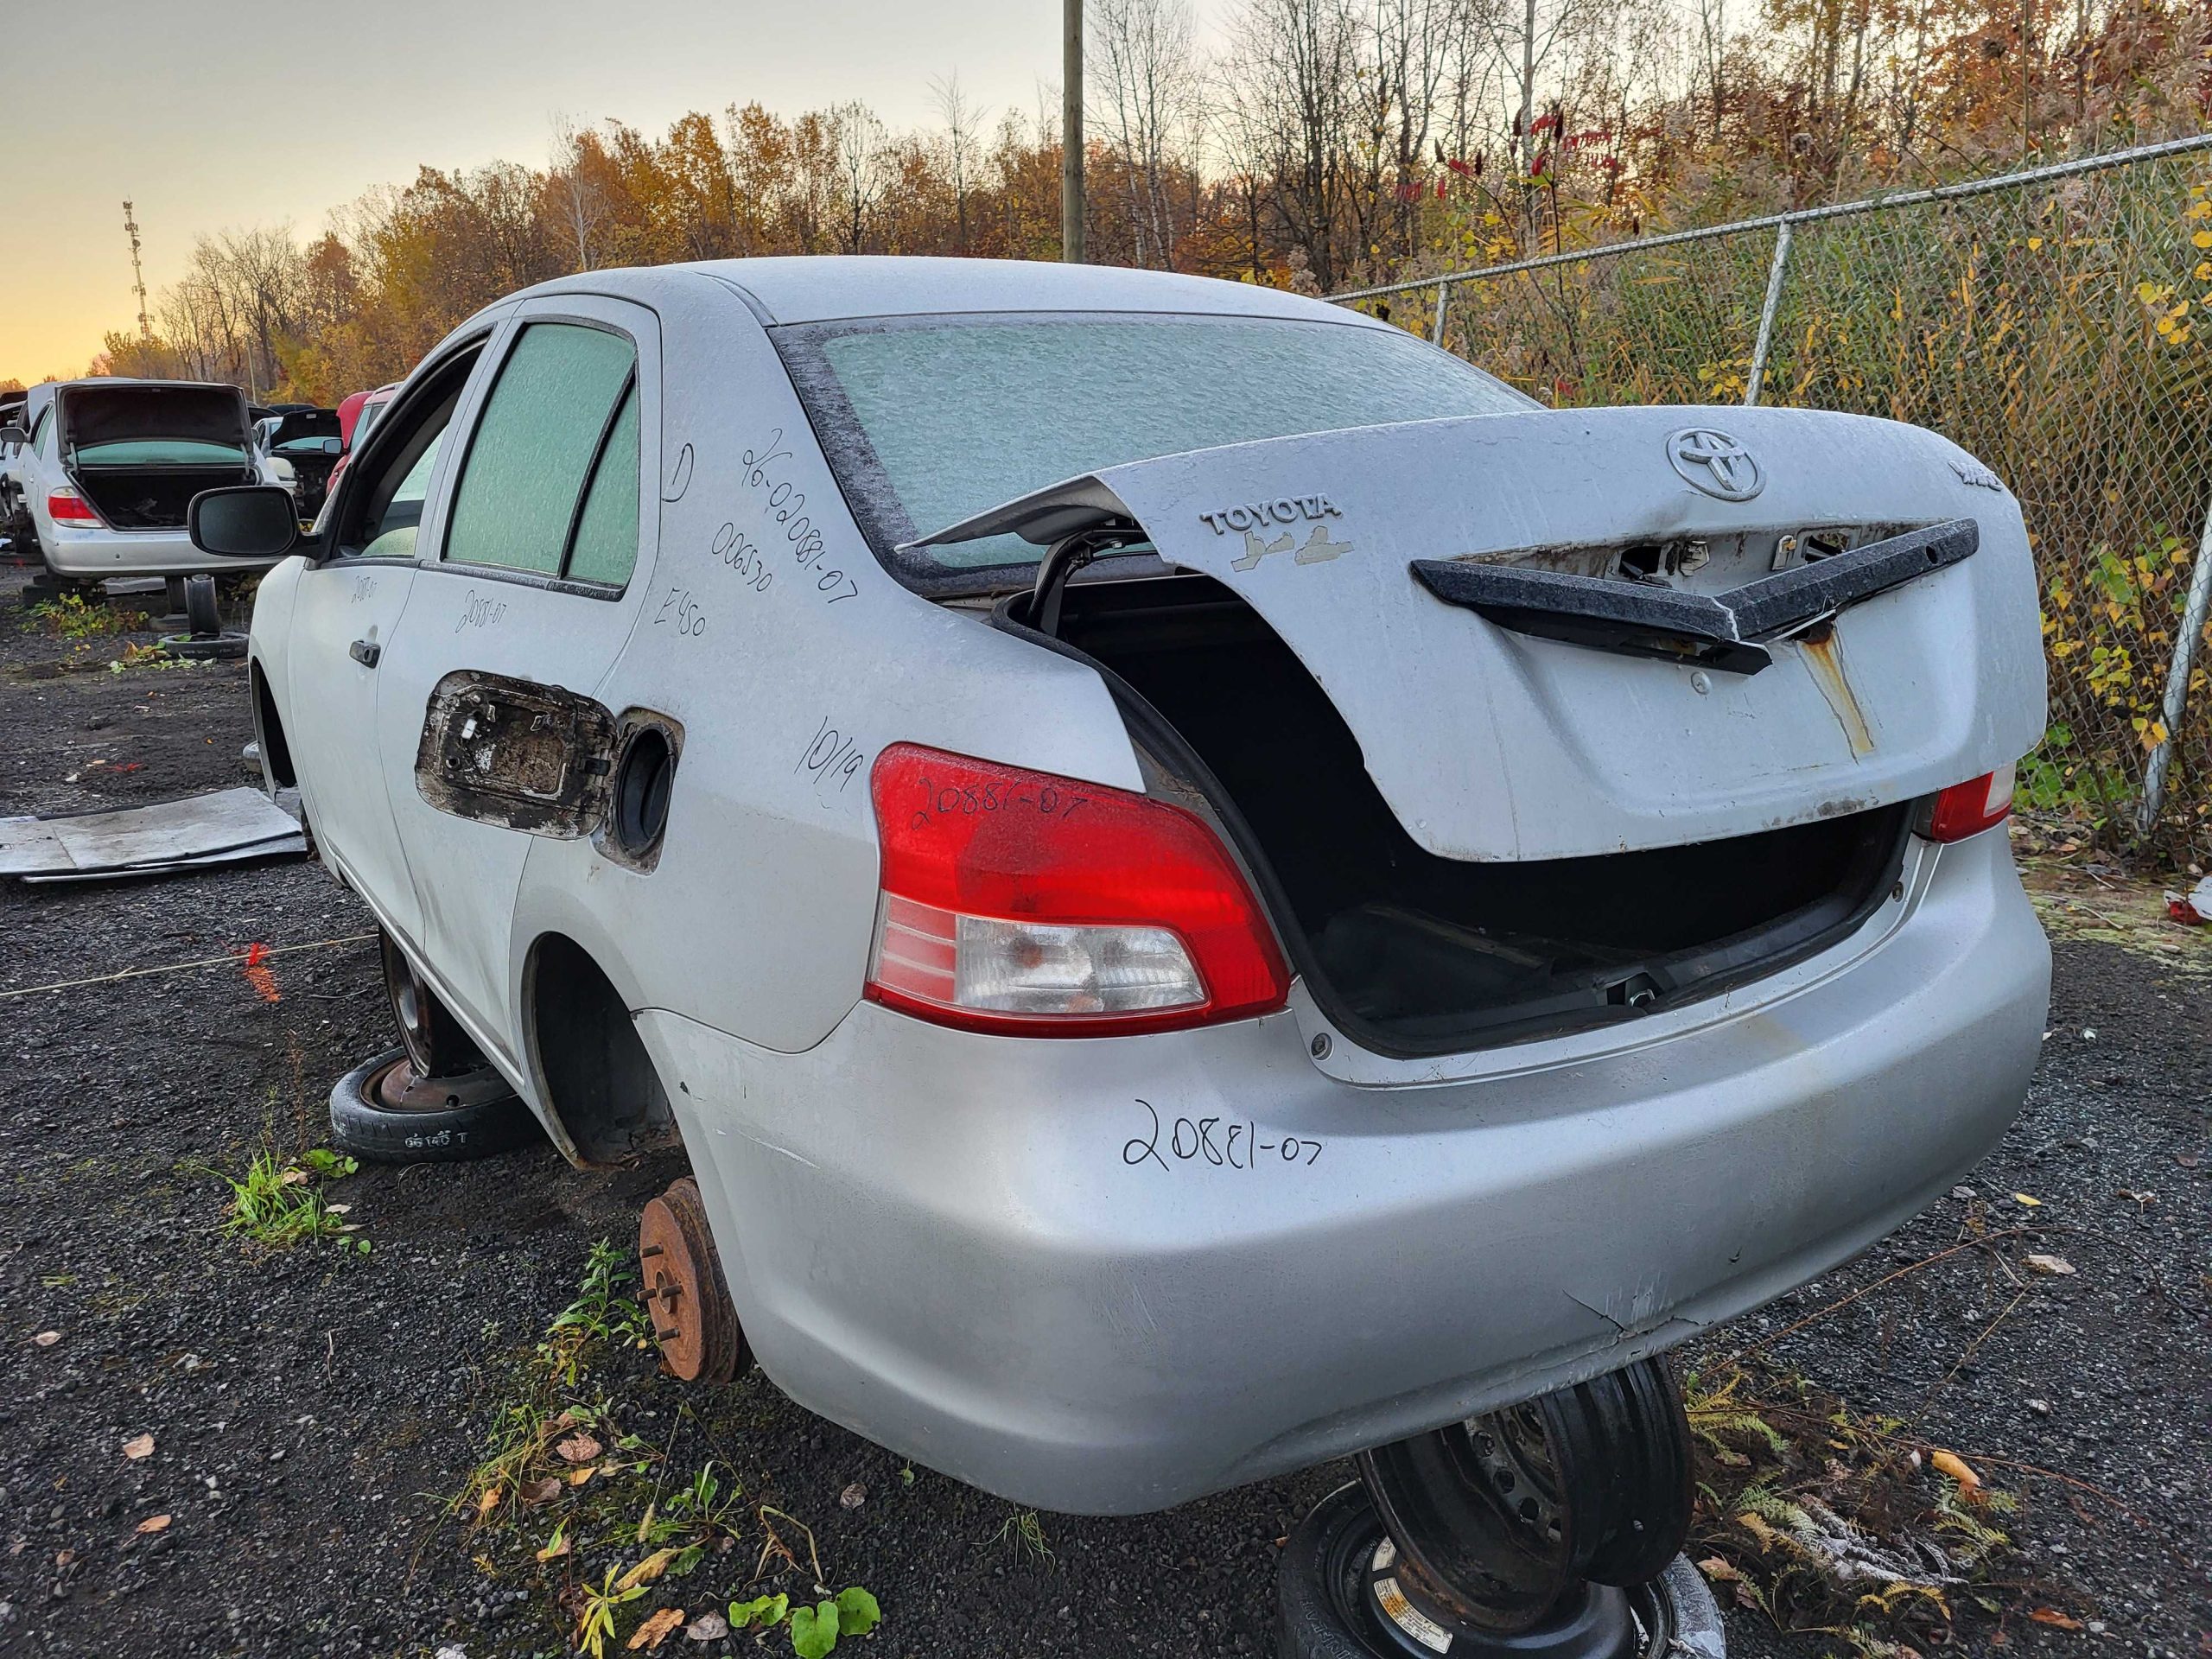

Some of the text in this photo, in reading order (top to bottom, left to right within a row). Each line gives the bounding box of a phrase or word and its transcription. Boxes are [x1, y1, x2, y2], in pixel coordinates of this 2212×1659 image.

[661, 442, 695, 503] D
[1199, 493, 1344, 536] TOYOTA
[912, 778, 1088, 831] 20881-07
